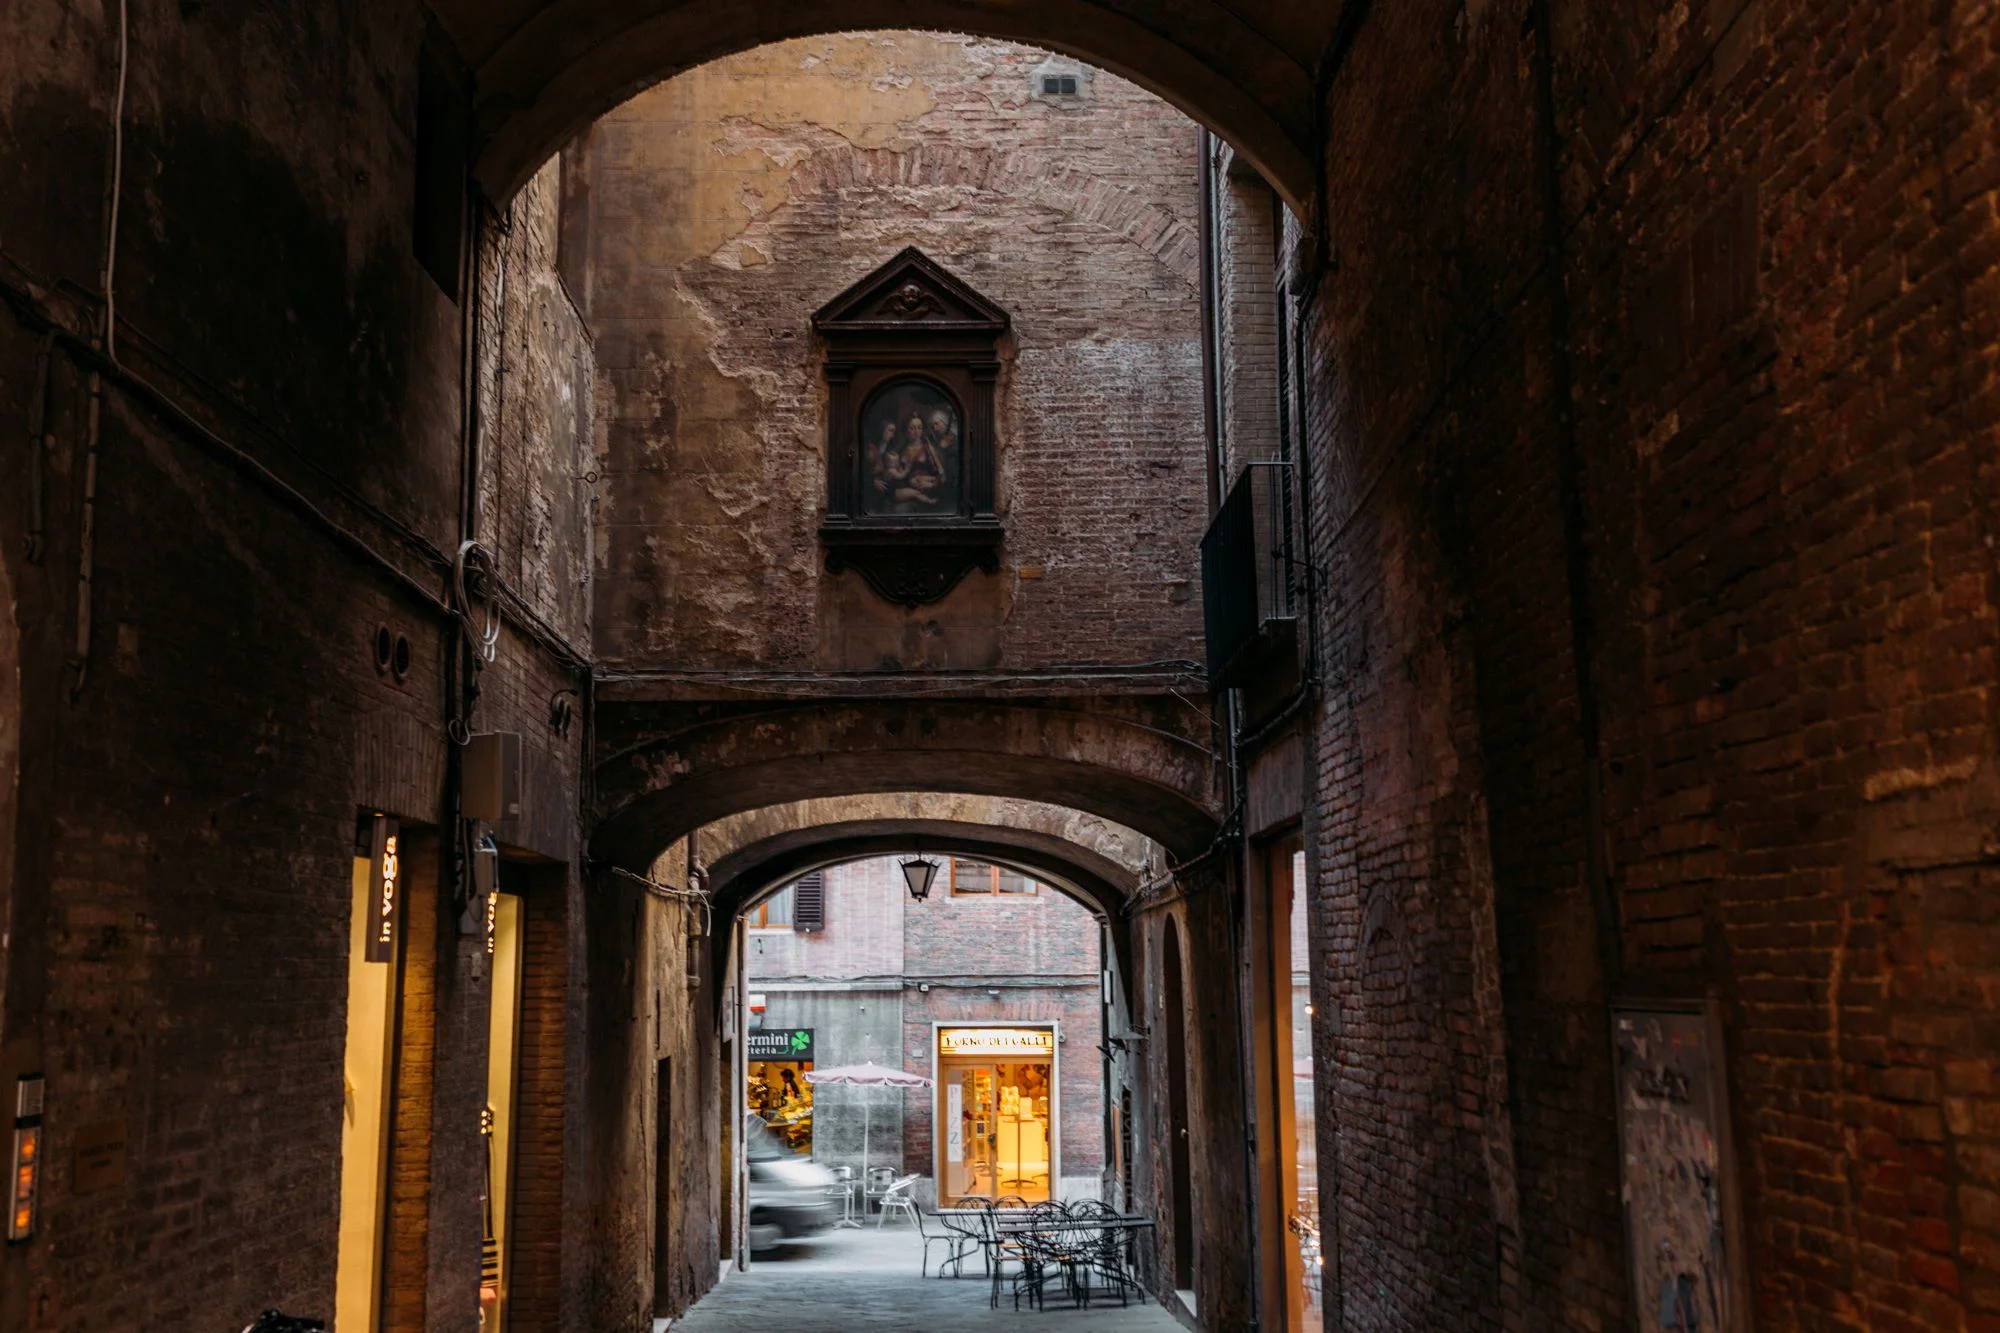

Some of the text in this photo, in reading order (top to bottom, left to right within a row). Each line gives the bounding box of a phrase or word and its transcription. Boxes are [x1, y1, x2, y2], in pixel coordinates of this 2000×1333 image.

[379, 835, 398, 943] in voga
[747, 1032, 788, 1046] ermini
[748, 1046, 777, 1055] teria
